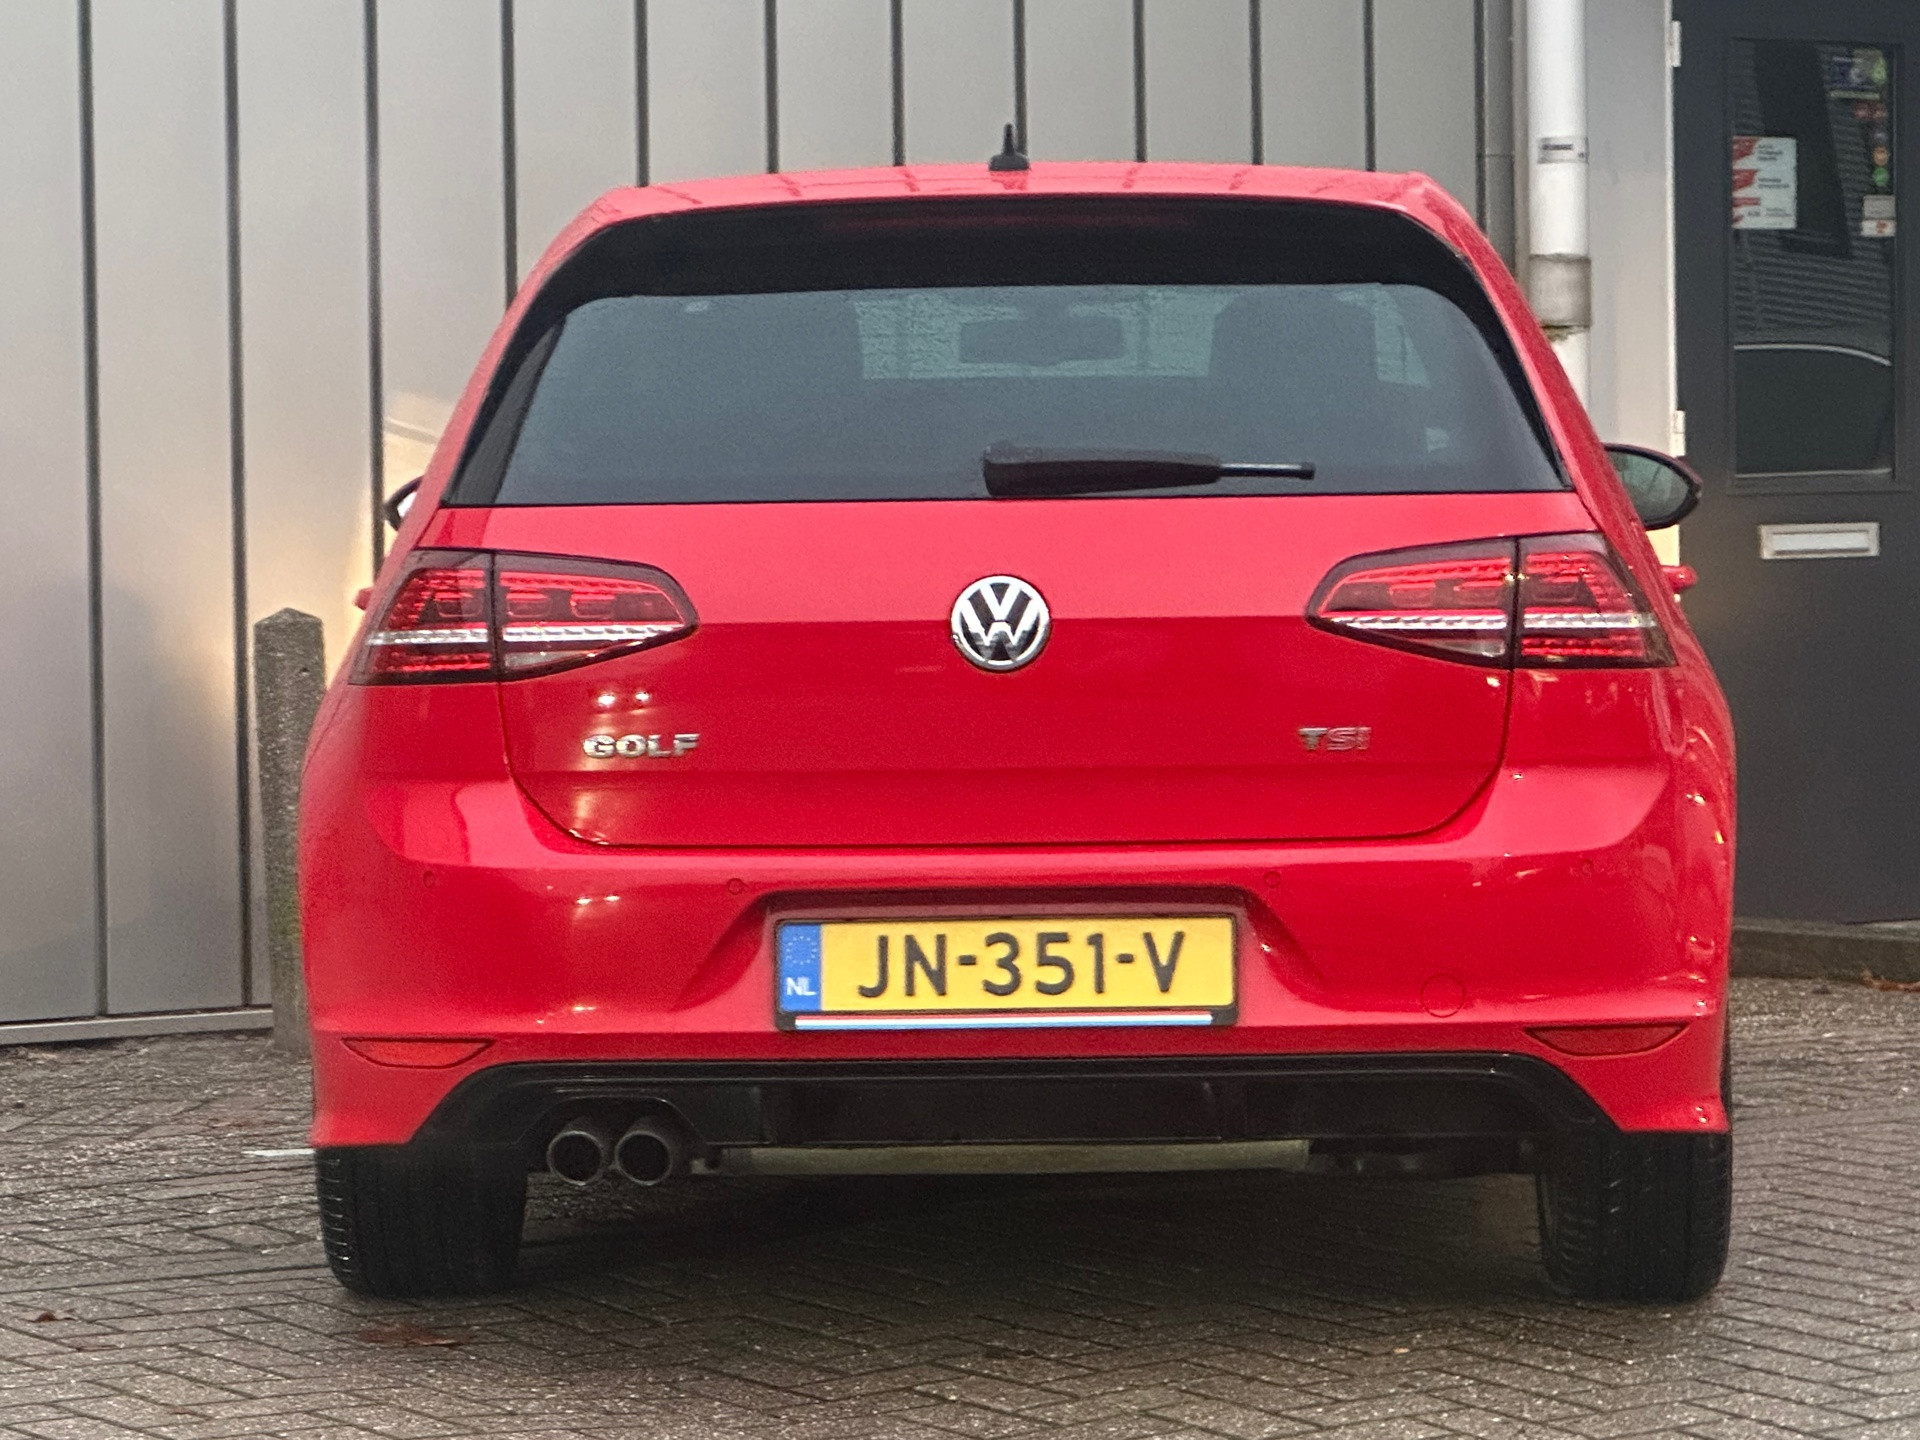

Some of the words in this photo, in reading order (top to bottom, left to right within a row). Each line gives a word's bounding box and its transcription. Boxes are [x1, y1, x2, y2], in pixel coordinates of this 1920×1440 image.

[954, 578, 1047, 666] VW
[583, 733, 700, 758] GOLF
[1299, 727, 1371, 750] TSI
[858, 931, 1185, 998] JN-351-V
[785, 976, 817, 996] NL
